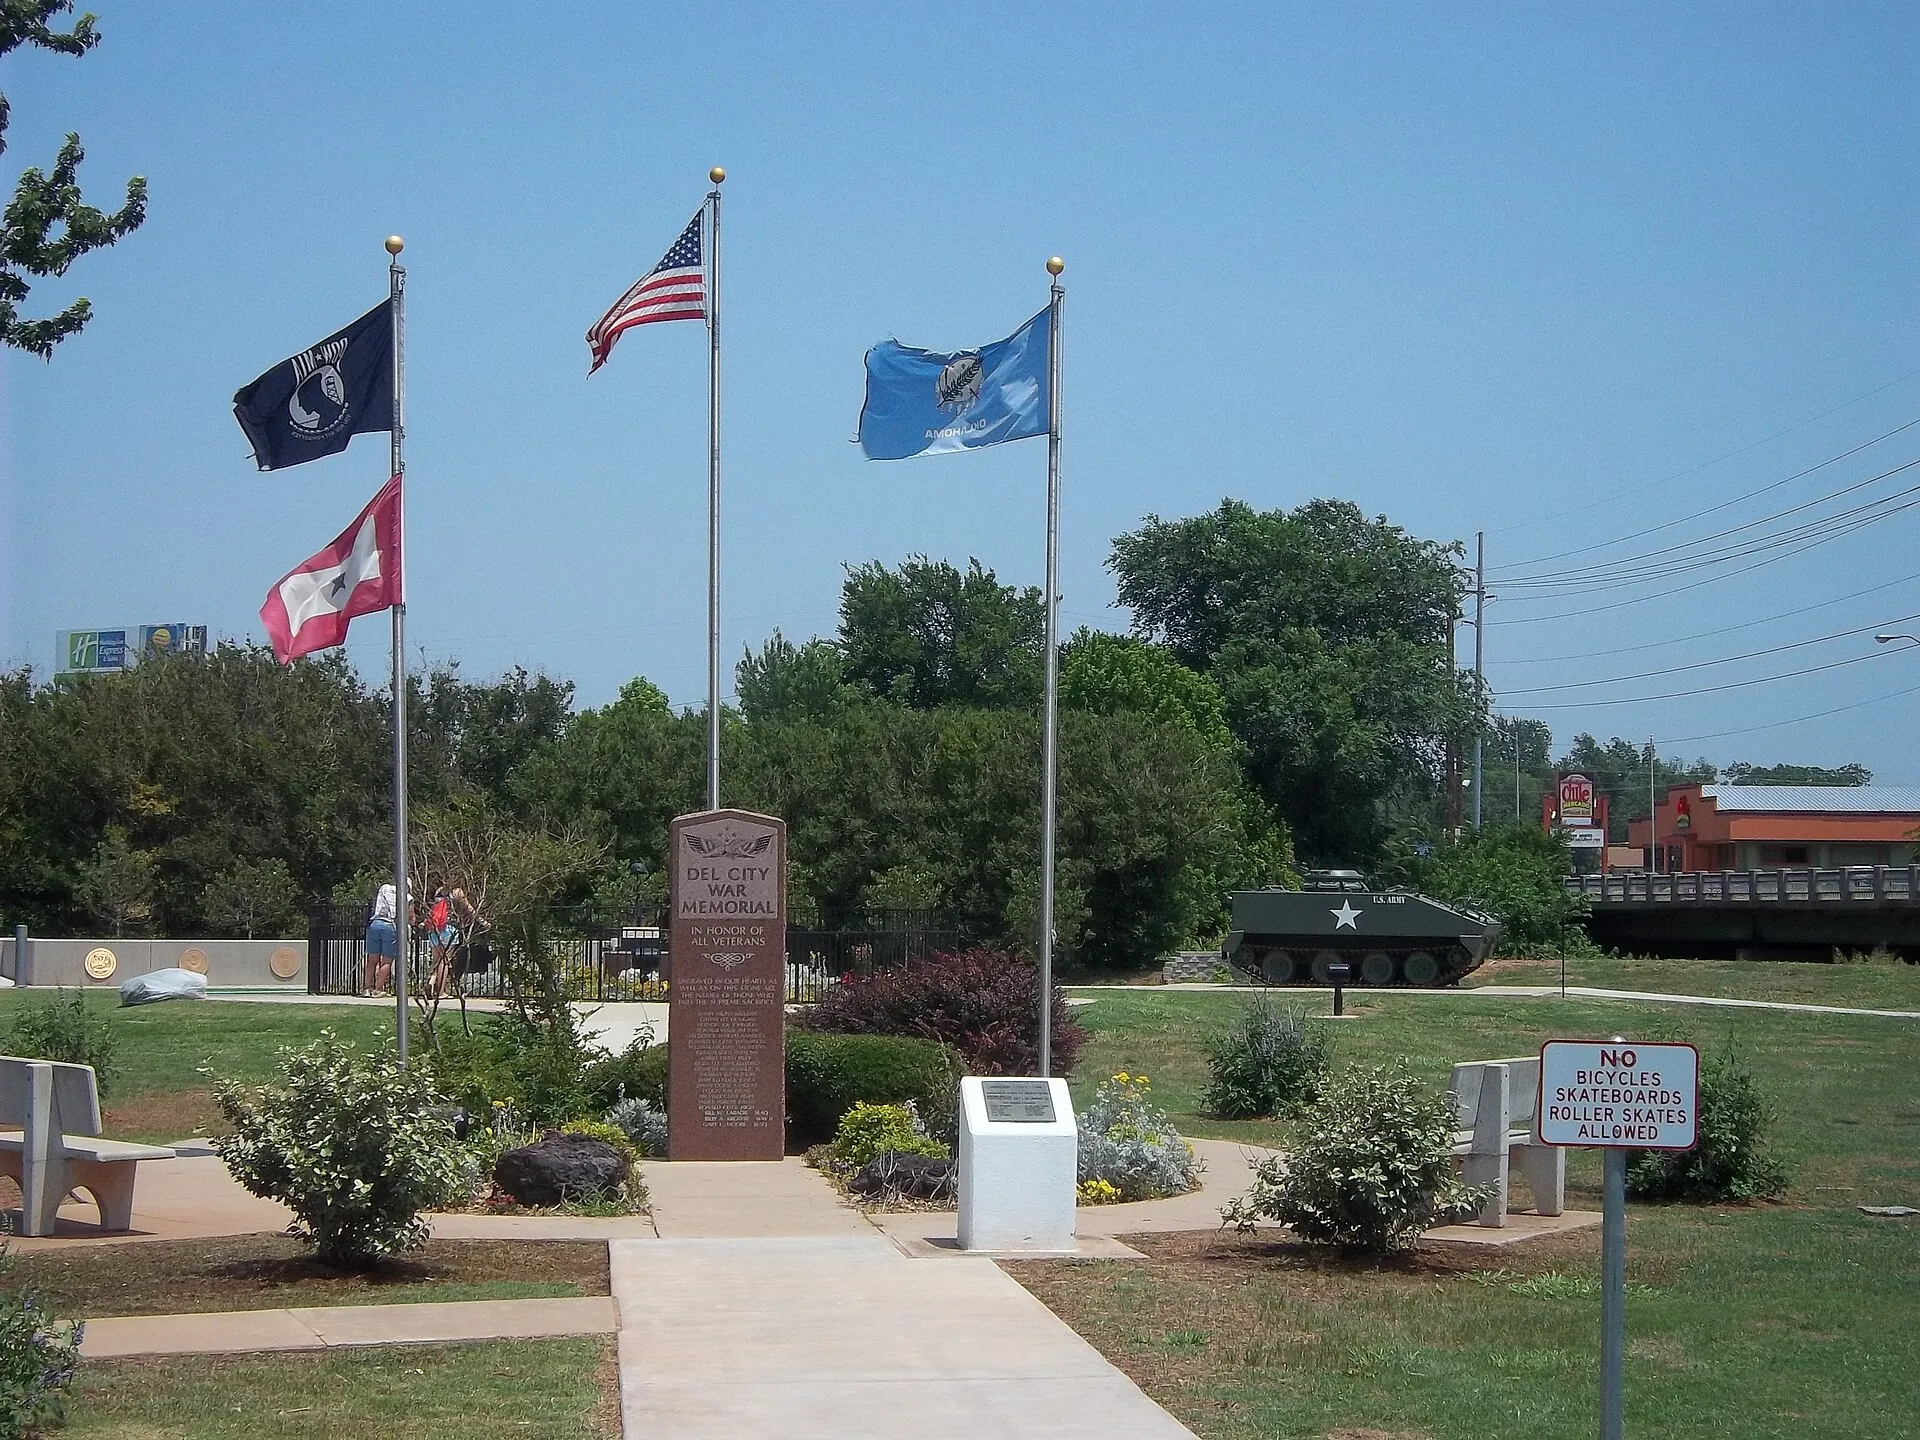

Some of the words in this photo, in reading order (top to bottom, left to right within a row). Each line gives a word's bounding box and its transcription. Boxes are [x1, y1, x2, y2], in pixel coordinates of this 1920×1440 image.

[687, 867, 720, 881] DEL
[727, 867, 770, 881] CITY
[707, 883, 747, 897] WAR
[681, 900, 775, 914] MEMORIAL
[1373, 896, 1386, 904] U.S.
[1387, 896, 1406, 904] ARMY
[691, 926, 702, 935] IN
[706, 926, 746, 935] HONOR
[750, 926, 764, 935] OF
[691, 937, 709, 946] ALL
[712, 937, 766, 946] VETERANS
[1600, 1049, 1637, 1068] NO
[1576, 1071, 1662, 1087] BICYCLES
[1556, 1087, 1682, 1105] SKATEBOARDS
[1549, 1106, 1614, 1122] ROLLER
[1622, 1108, 1687, 1124] SKATES
[1577, 1124, 1659, 1140] ALLOWED
